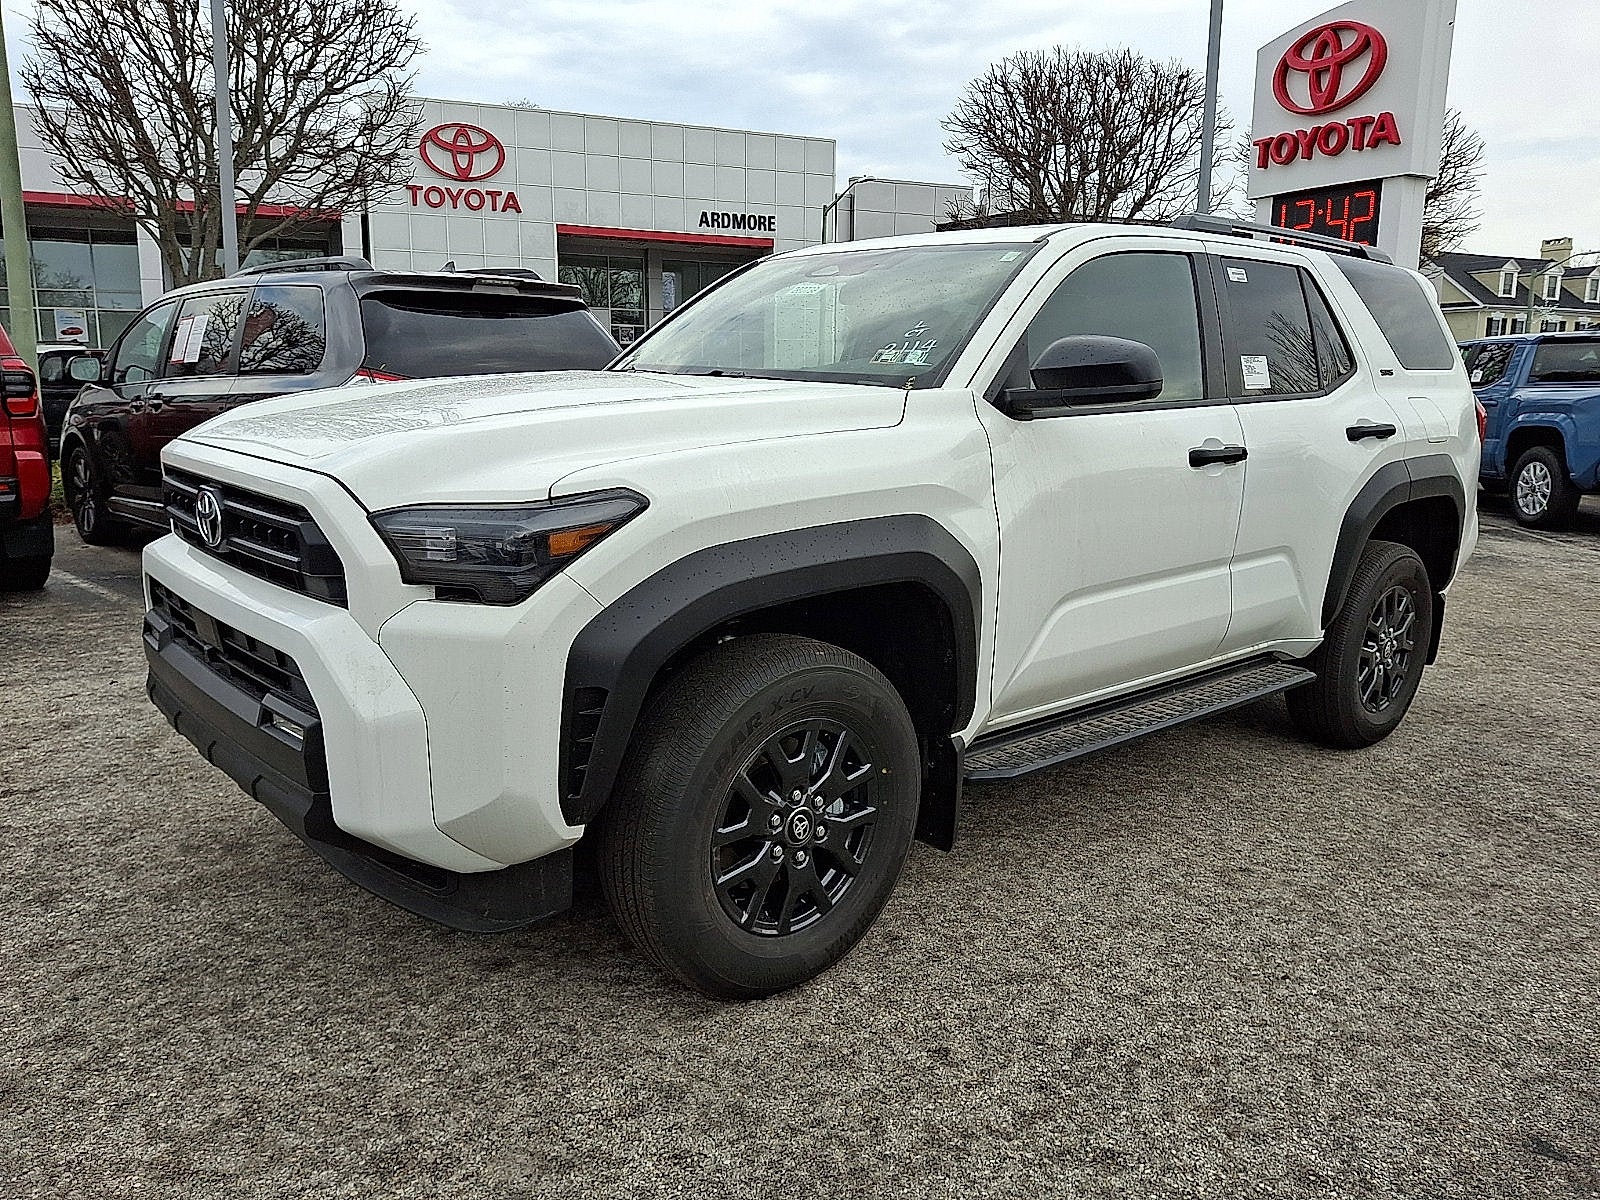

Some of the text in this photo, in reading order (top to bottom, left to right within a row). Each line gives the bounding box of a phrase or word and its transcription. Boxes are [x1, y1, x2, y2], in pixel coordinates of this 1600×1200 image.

[1253, 112, 1401, 169] TOYOTA
[405, 184, 522, 213] TOYOTA
[698, 211, 776, 232] ARDMORE
